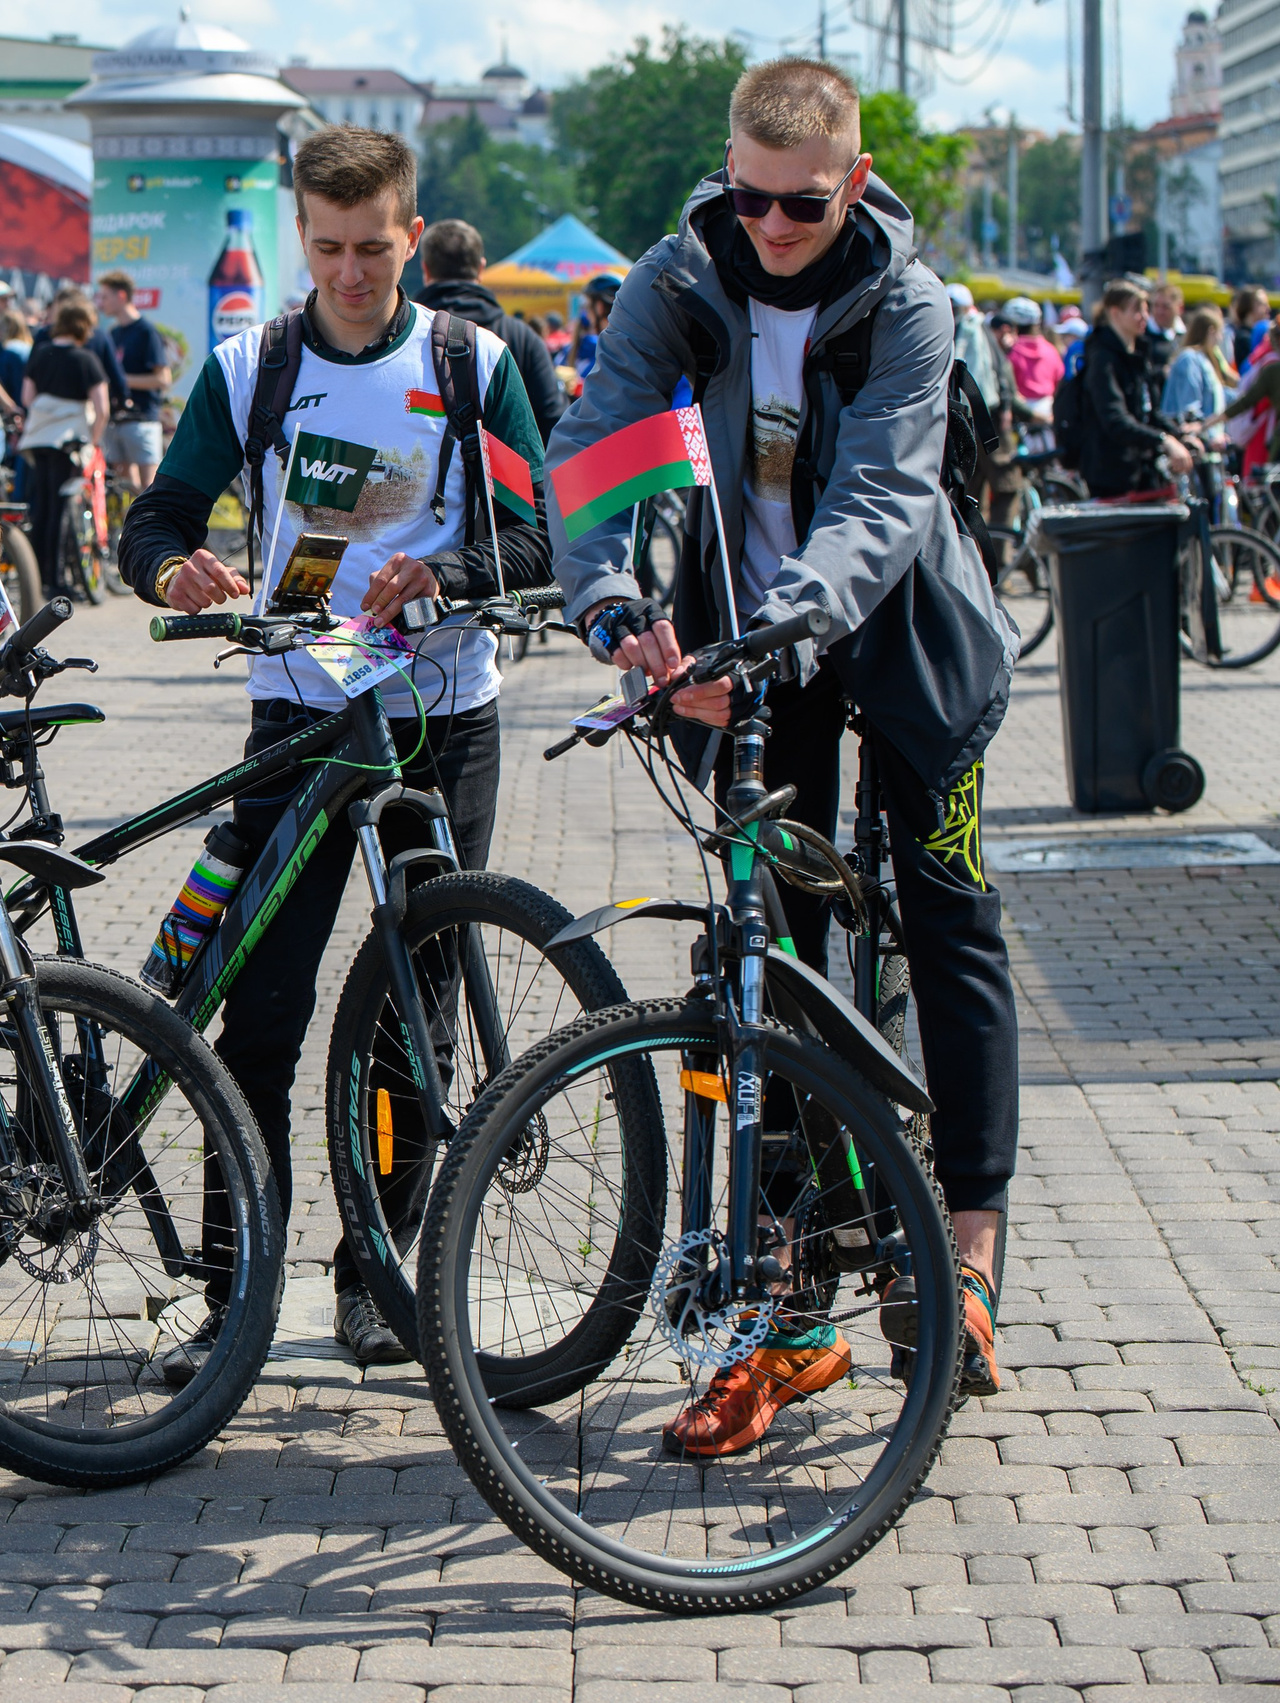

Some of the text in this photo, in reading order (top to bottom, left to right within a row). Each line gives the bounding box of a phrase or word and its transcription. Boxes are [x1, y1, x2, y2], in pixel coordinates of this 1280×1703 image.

[341, 664, 373, 687] 11858
[217, 743, 290, 787] REBEL 940
[54, 884, 75, 951] REBEL
[348, 1050, 367, 1181] STAGE
